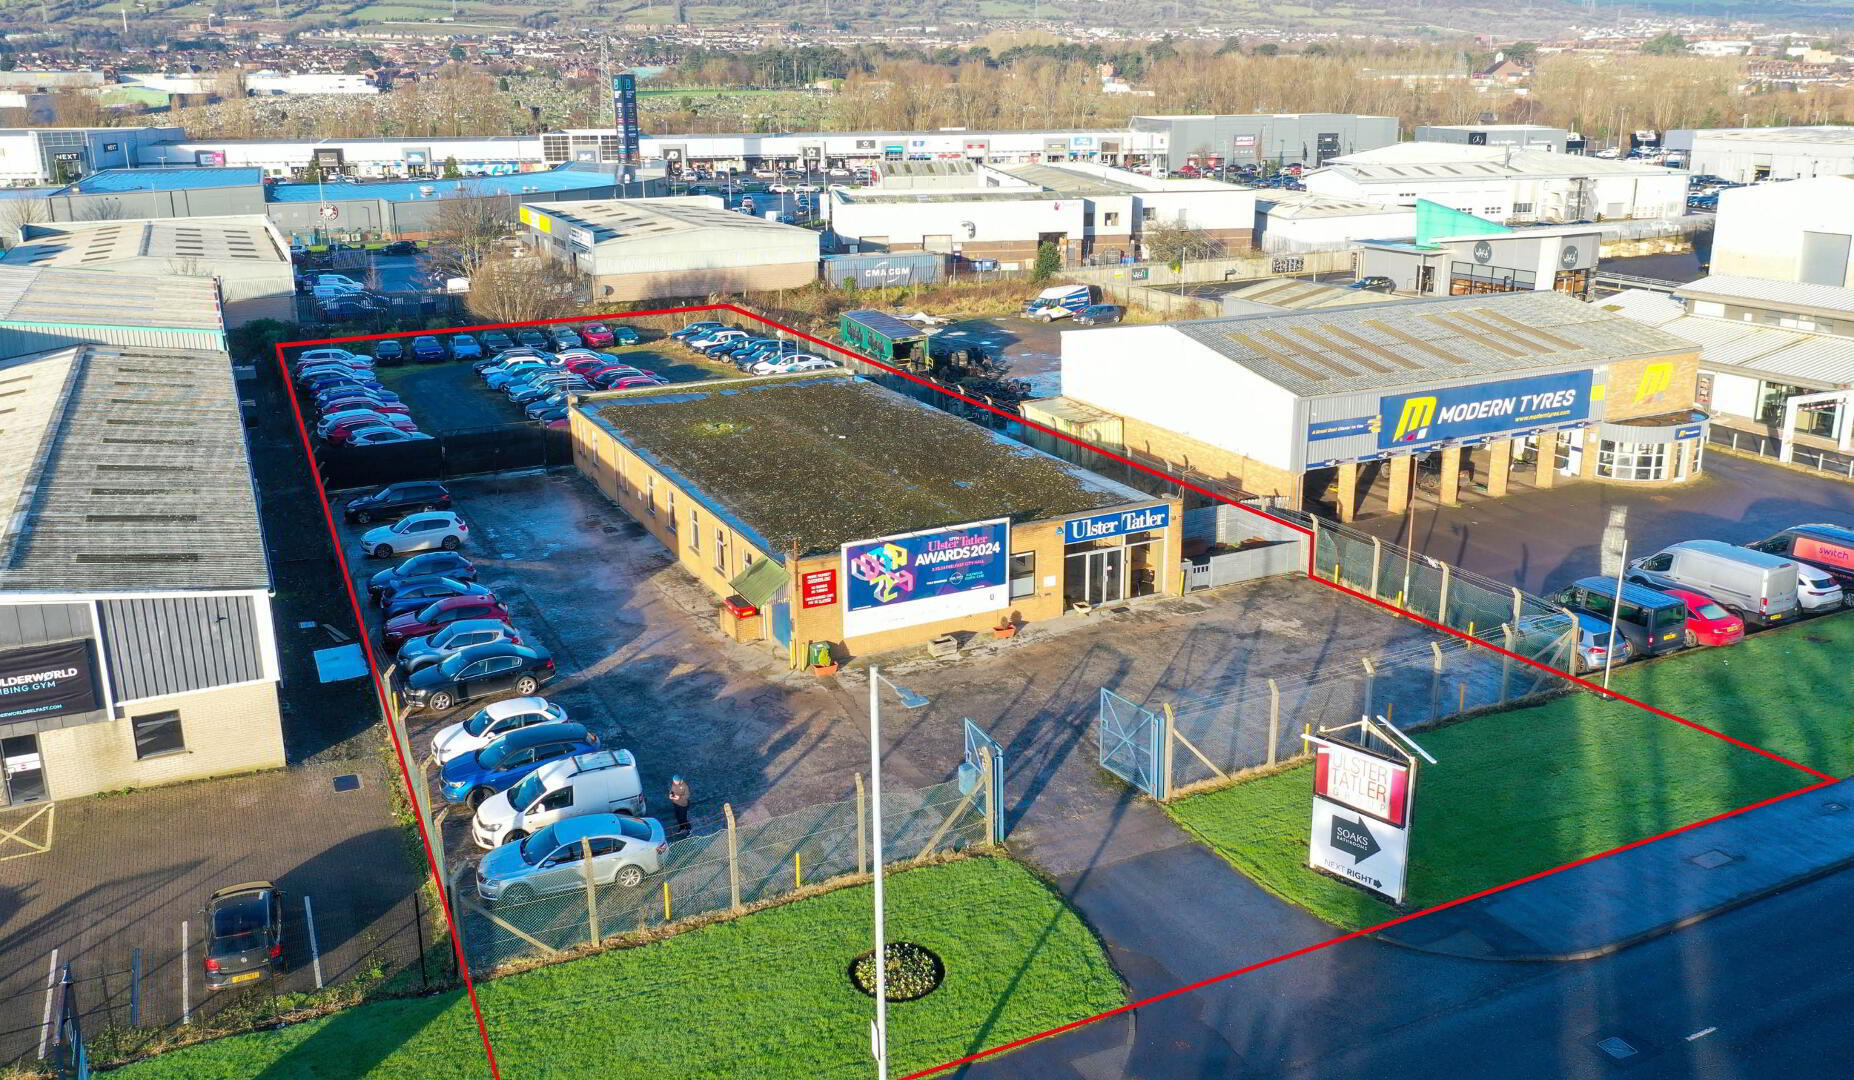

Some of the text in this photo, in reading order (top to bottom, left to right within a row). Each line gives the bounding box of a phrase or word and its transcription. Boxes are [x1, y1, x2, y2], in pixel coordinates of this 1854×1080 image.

[865, 267, 910, 277] CMA CGM
[1437, 389, 1577, 425] MODERN TYRES
[1071, 509, 1165, 539] Ulster Tatler
[927, 533, 989, 552] Ulster Tatler
[915, 541, 1000, 567] AWARDS 2024
[1818, 546, 1849, 560] switch
[0, 667, 78, 687] LDERWØRLD
[32, 681, 56, 691] GYM
[1332, 749, 1388, 785] ULSTER
[1332, 767, 1386, 802] TATLER
[1336, 826, 1369, 846] SOAKS
[1336, 835, 1368, 851] BATHROOMS
[1324, 858, 1373, 886] NEXT RIGHT
